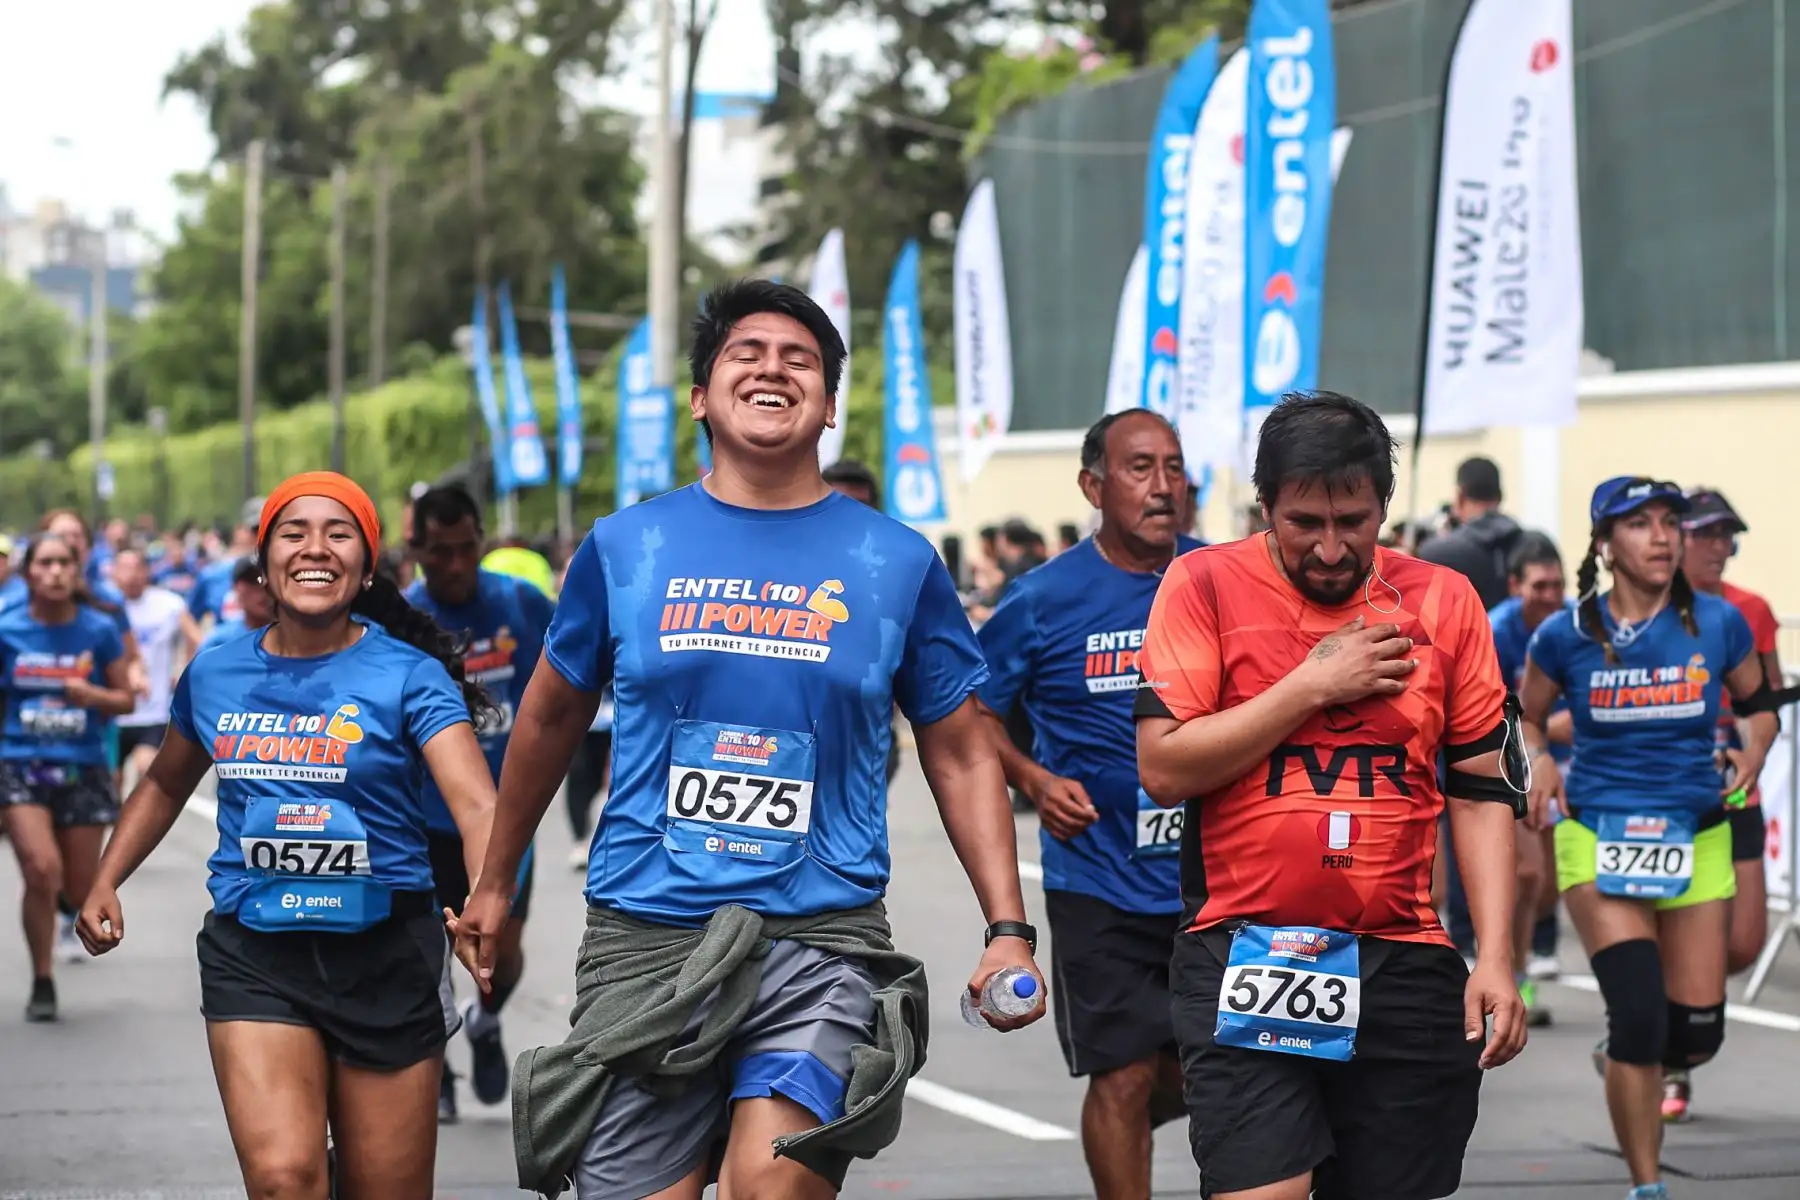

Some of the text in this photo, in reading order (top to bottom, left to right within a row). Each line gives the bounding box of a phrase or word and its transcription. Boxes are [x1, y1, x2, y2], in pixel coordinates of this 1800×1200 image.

[1263, 26, 1314, 247] entel
[1444, 178, 1492, 372] HUAWEI
[665, 577, 807, 605] ENTEL (10)
[699, 602, 833, 641] POWER
[668, 638, 822, 659] TU INTERNET TE POTENCIA
[1590, 668, 1652, 688] ENTEL
[1615, 681, 1704, 709] POWER
[216, 713, 326, 734] ENTEL (10)
[235, 734, 348, 764] POWER
[228, 768, 273, 776] INTERNET
[278, 769, 288, 777] TE
[293, 770, 340, 780] POTENCIA
[675, 771, 802, 828] 0575
[251, 841, 357, 876] 0574
[728, 842, 763, 855] entel
[1321, 852, 1354, 870] PERÚ
[1602, 845, 1684, 875] 3740
[305, 895, 342, 908] entel
[1227, 968, 1347, 1023] 5763
[1279, 1035, 1312, 1050] entel
